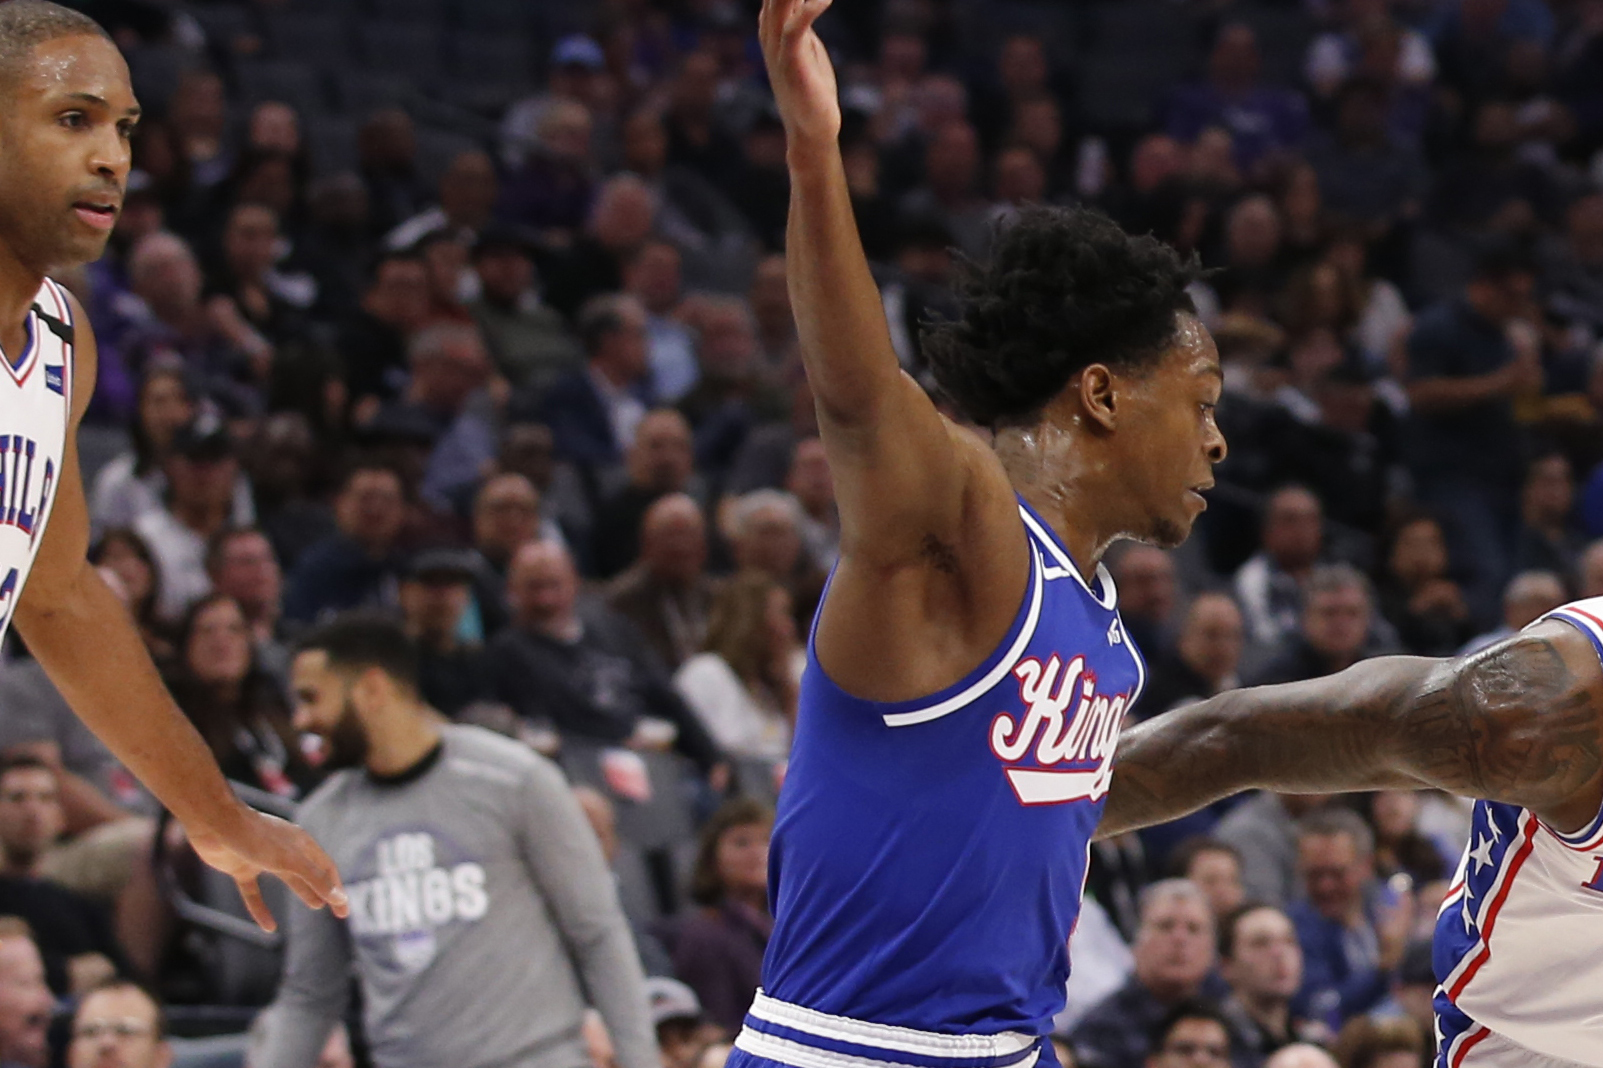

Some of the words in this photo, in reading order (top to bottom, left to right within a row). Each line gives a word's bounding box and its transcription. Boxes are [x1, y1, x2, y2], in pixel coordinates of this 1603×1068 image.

[989, 653, 1132, 802] King
[376, 831, 434, 876] LOS
[347, 862, 490, 935] KINGS
